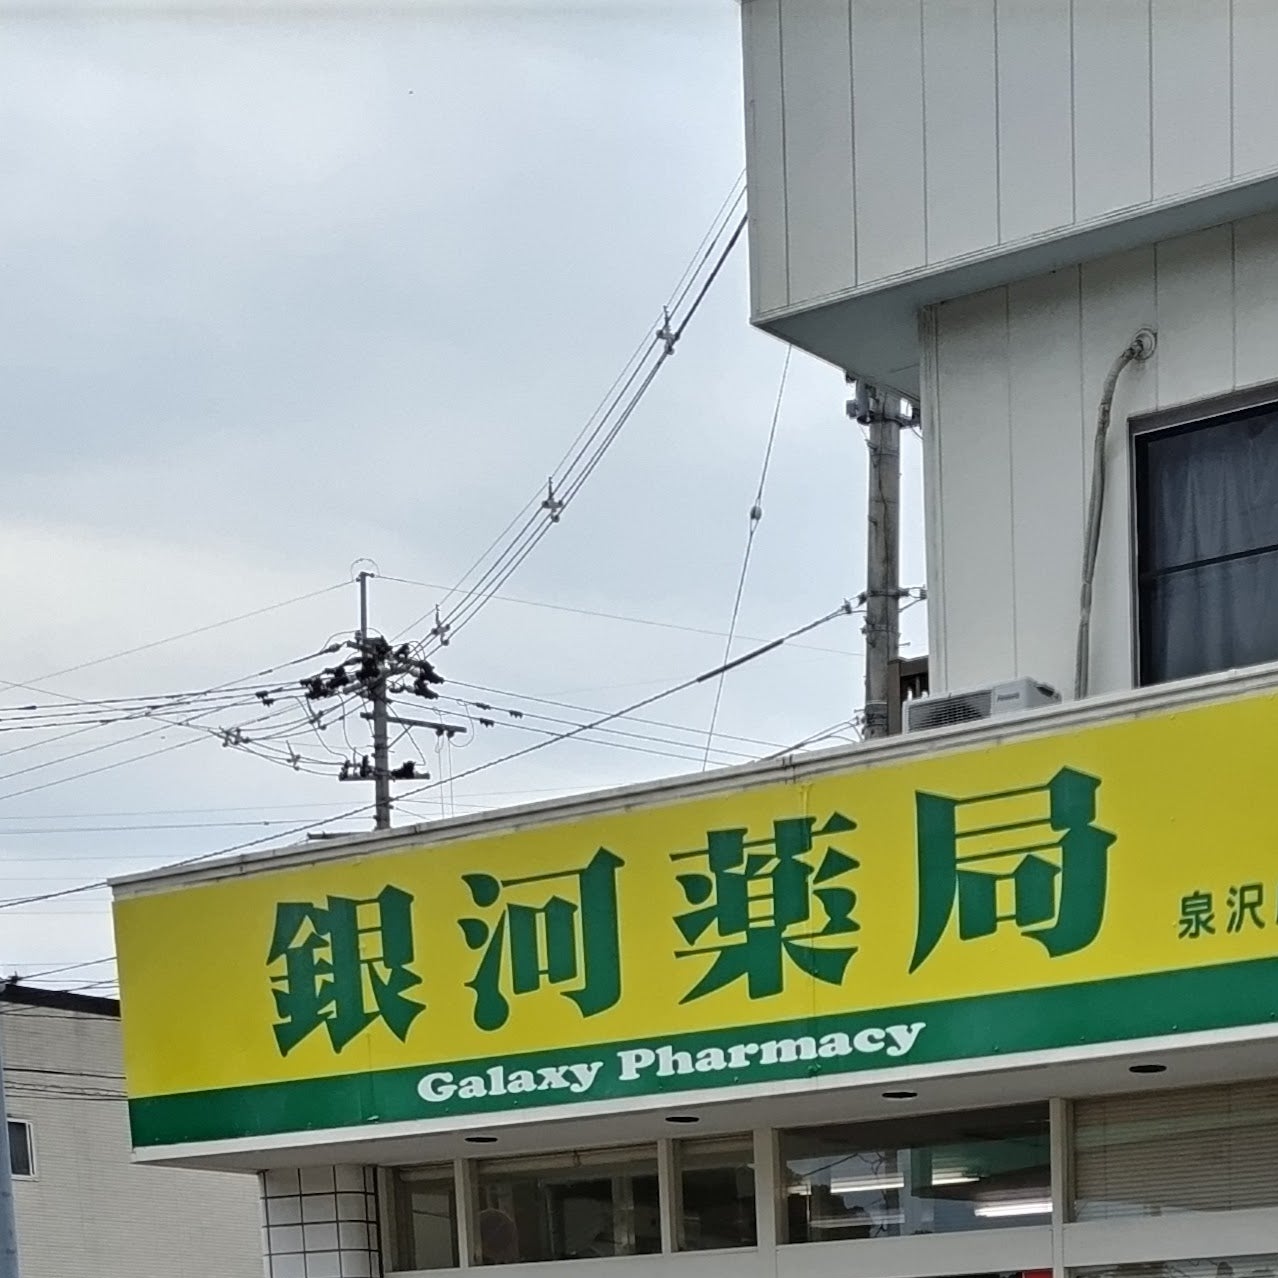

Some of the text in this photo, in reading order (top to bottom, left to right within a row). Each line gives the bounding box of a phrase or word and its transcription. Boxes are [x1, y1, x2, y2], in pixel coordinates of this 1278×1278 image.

[265, 766, 1117, 1058] 銀河薬局
[417, 1022, 927, 1103] Galaxy Pharmacy
